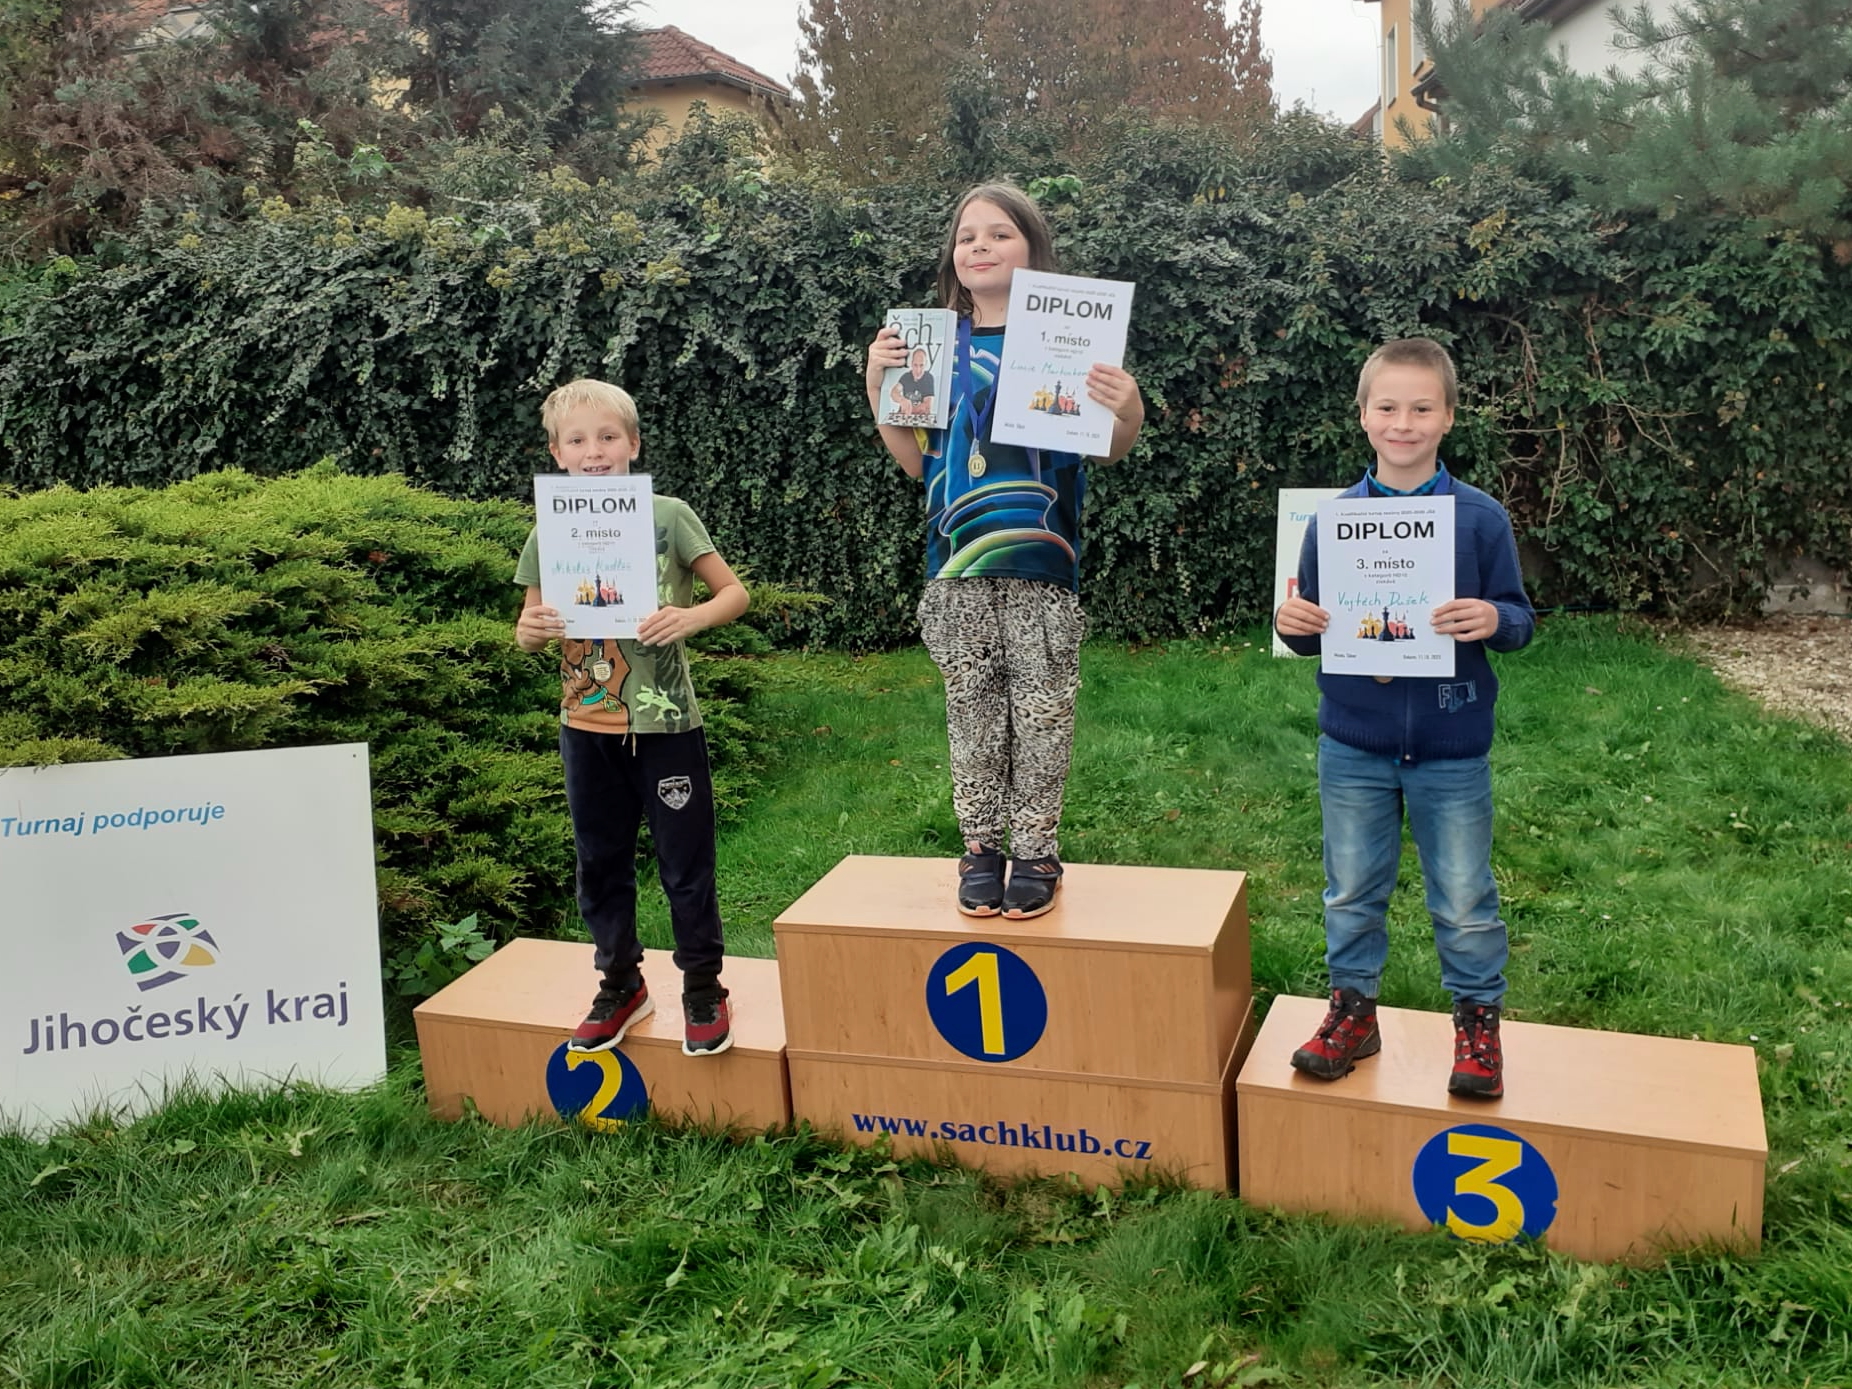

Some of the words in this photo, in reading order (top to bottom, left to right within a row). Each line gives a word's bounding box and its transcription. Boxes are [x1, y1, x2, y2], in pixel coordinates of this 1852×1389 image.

[1026, 294, 1113, 320] DIPLOM
[1040, 331, 1050, 343] 1.
[1054, 333, 1091, 348] místo
[552, 497, 637, 514] DIPLOM
[571, 527, 581, 538] 2.
[586, 527, 621, 538] místo
[1336, 521, 1435, 540] DIPLOM
[1356, 558, 1369, 570] 3.
[1373, 556, 1415, 569] místo
[1, 811, 86, 837] Turnaj
[92, 801, 226, 834] podporuje
[23, 993, 250, 1055] Jihočeský
[266, 982, 349, 1026] kraj
[945, 951, 1006, 1056] 1
[565, 1049, 628, 1134] 2
[851, 1112, 1154, 1161] www.sachklub.cz
[1446, 1132, 1525, 1244] 3
